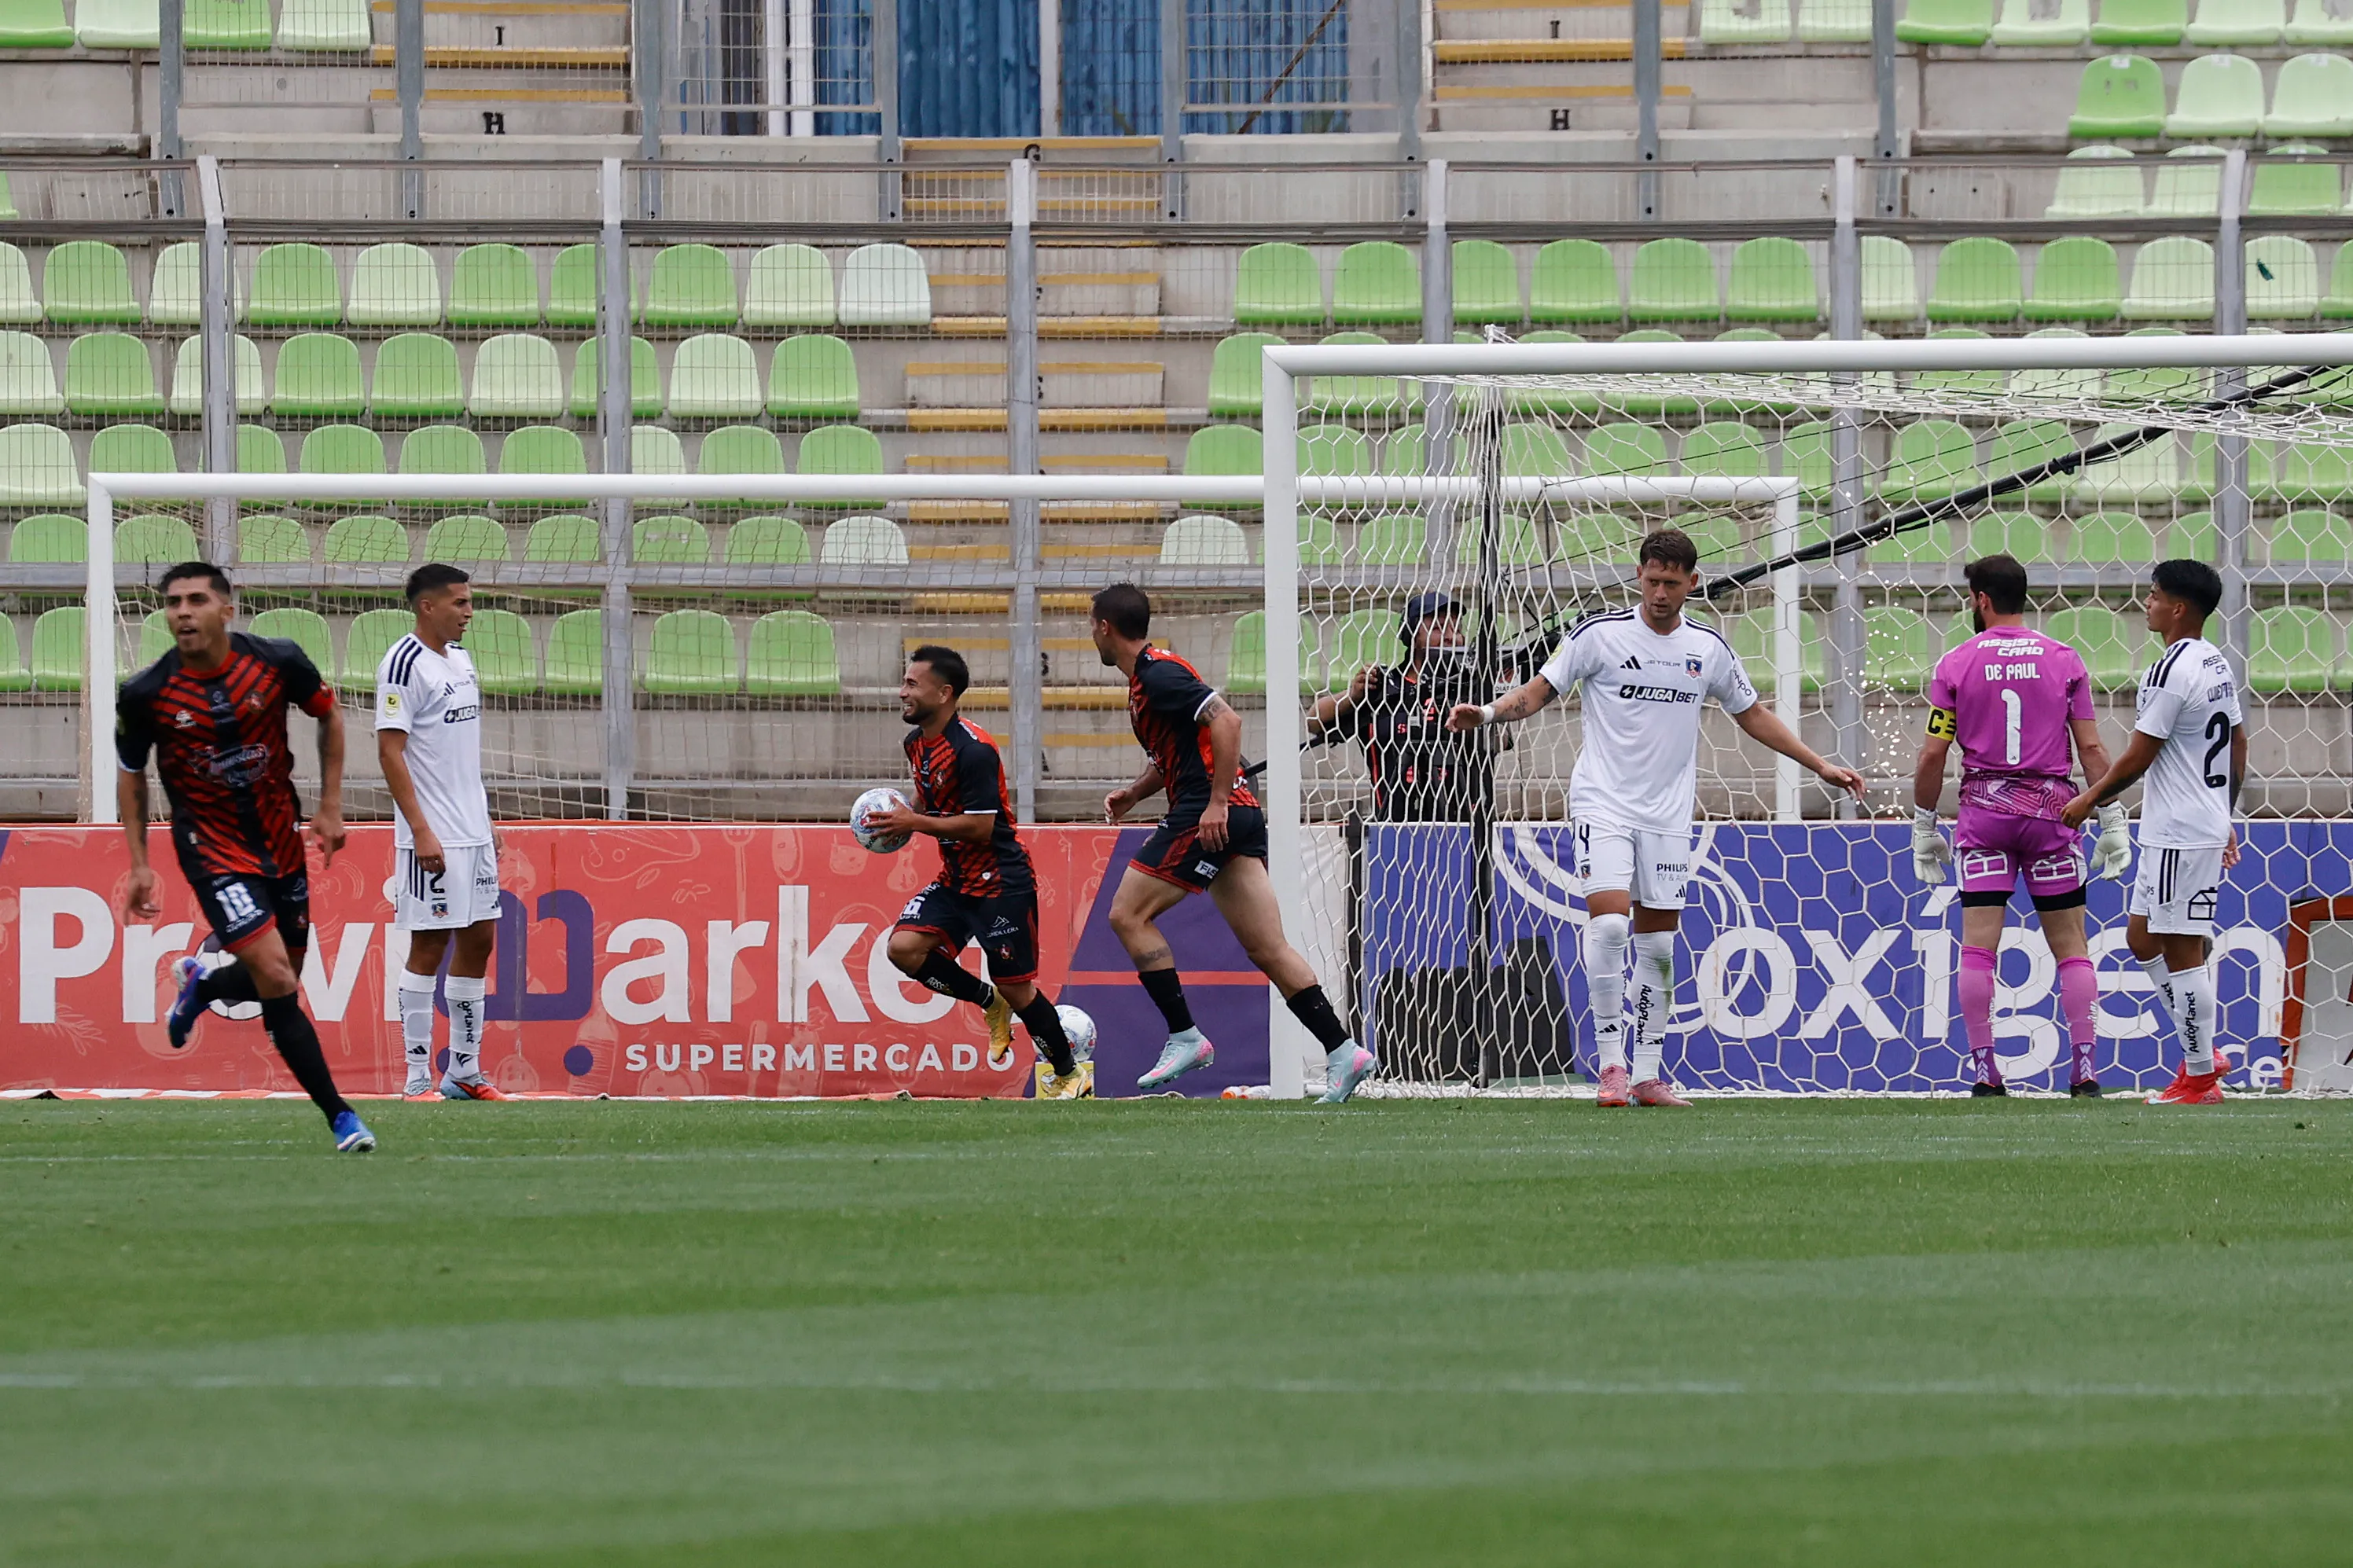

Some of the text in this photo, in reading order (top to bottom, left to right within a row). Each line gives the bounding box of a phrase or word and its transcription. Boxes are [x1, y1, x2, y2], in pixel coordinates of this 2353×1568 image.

[482, 111, 506, 136] H
[1549, 108, 1571, 131] H
[1976, 637, 2040, 650] ASSIST
[1997, 646, 2045, 658] CARD
[1984, 662, 2041, 681] DE PAUL
[1928, 708, 1945, 735] C
[2001, 689, 2021, 766] 1
[2204, 711, 2230, 789] 2
[625, 1043, 1016, 1073] SUPERMERCADO
